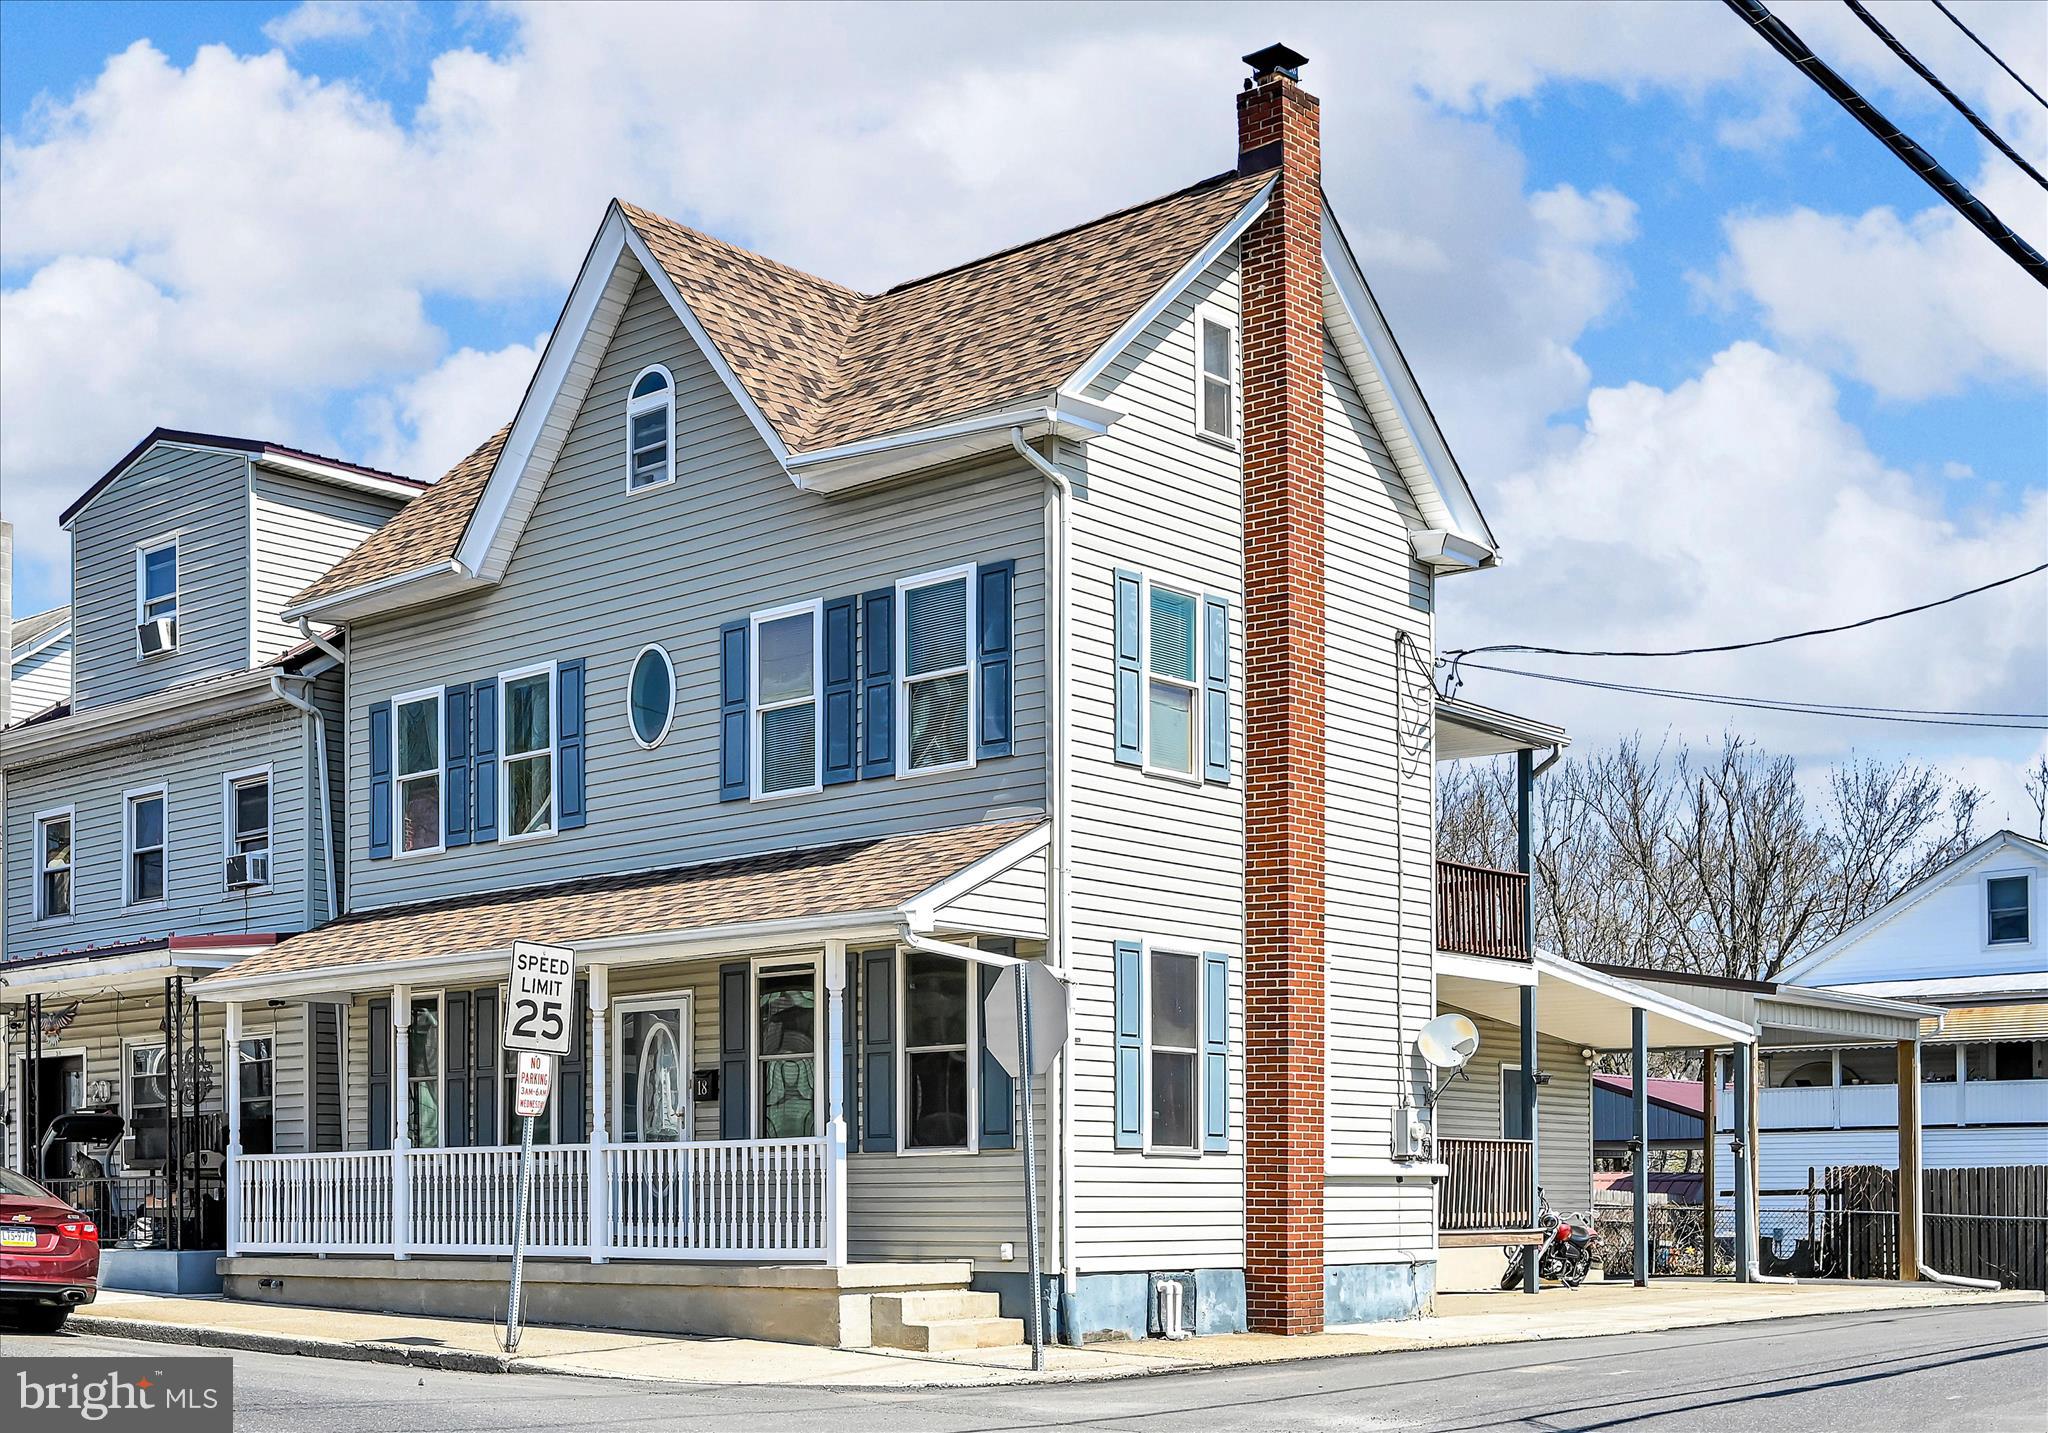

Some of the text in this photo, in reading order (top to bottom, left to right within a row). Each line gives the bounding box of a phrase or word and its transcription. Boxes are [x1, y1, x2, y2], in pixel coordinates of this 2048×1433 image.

[517, 954, 569, 976] SPEED
[521, 977, 563, 997] LIMIT
[512, 999, 564, 1040] 25
[530, 1057, 541, 1070] NO
[520, 1072, 548, 1086] PARKING
[697, 1080, 708, 1096] 18
